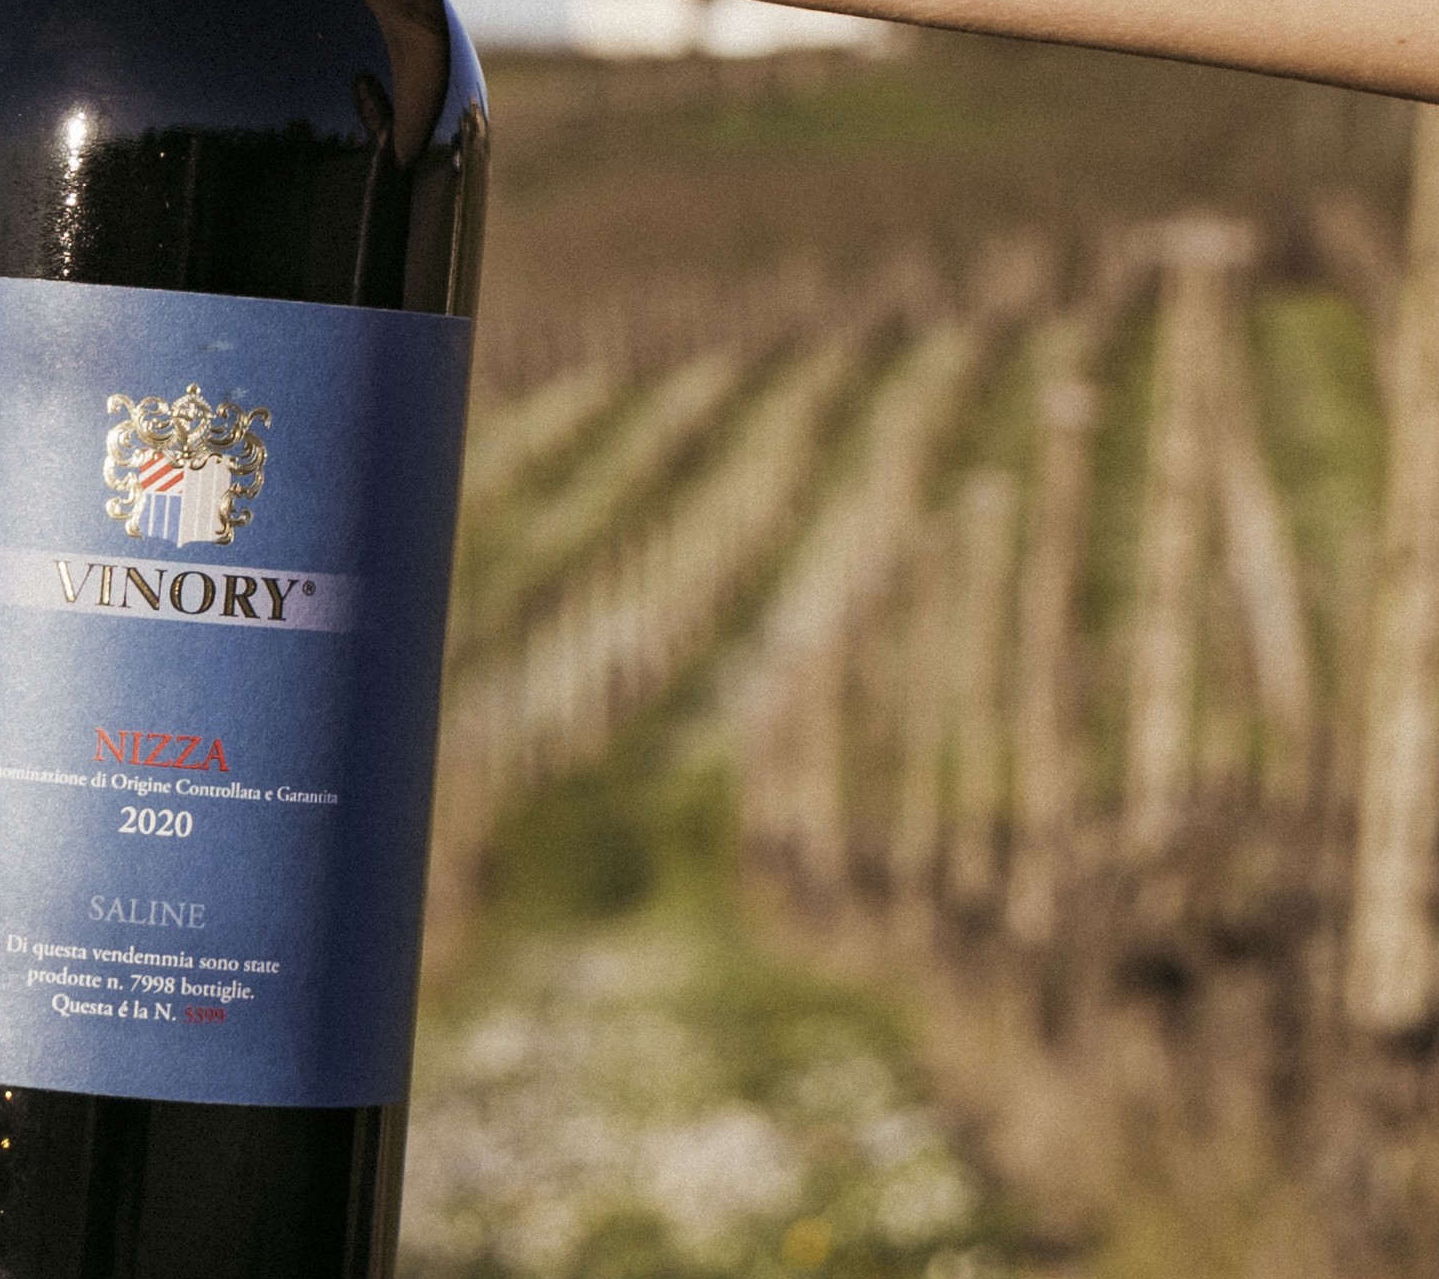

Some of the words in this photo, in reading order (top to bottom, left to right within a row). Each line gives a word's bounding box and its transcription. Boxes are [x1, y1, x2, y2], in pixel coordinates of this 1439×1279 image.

[93, 726, 230, 772] NIZZA
[90, 772, 107, 788] di
[111, 773, 172, 796] Origine
[175, 778, 261, 800] Controllata
[264, 789, 274, 801] e
[276, 786, 338, 804] Garantita
[118, 805, 193, 838] 2020
[89, 895, 206, 929] SALINE
[6, 934, 28, 953] Di
[32, 941, 87, 961] questa
[92, 945, 194, 969] vendemmia
[199, 956, 240, 971] sono
[243, 959, 281, 974] state
[27, 965, 102, 988] prodotte
[106, 977, 124, 990] n.
[130, 974, 175, 994] 7998
[181, 976, 255, 1004] bottiglie.
[51, 993, 113, 1017] Questa
[117, 1000, 129, 1018] é
[133, 999, 149, 1020] la
[154, 1002, 177, 1021] N.
